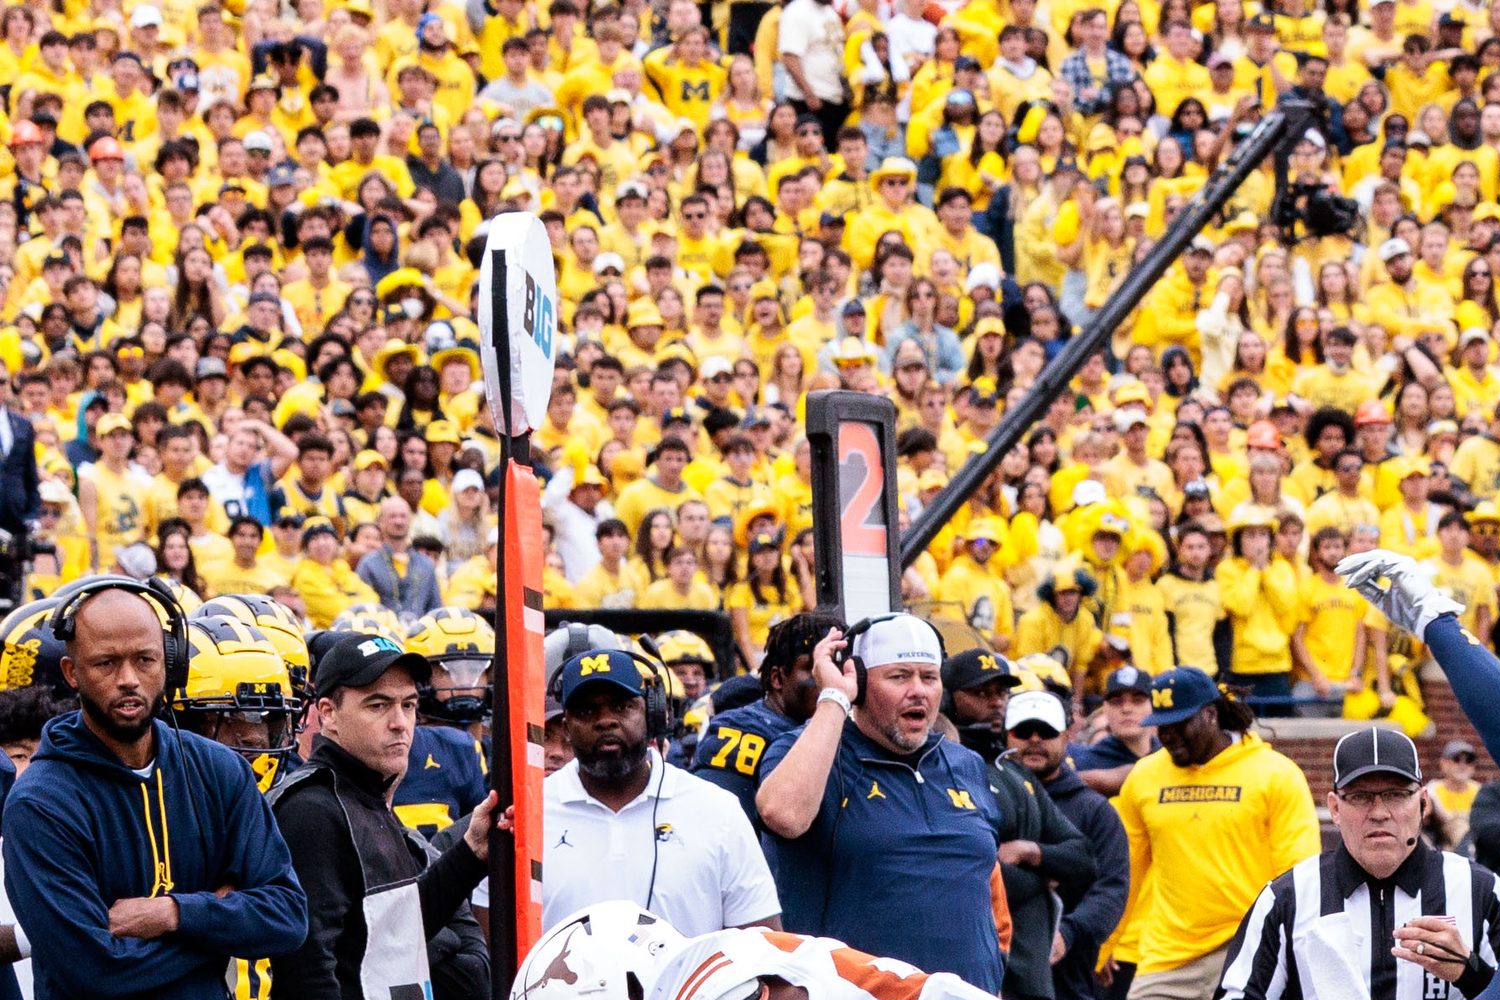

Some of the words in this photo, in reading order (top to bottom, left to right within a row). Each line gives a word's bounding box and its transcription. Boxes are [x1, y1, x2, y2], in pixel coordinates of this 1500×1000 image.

[681, 80, 710, 101] M
[838, 420, 887, 555] 2
[580, 653, 611, 676] M
[977, 654, 999, 670] M
[254, 683, 267, 694] M
[1151, 687, 1173, 708] M
[710, 727, 766, 776] 78
[946, 788, 977, 810] M
[1160, 785, 1241, 803] MICHIGAN
[1425, 971, 1447, 1000] H
